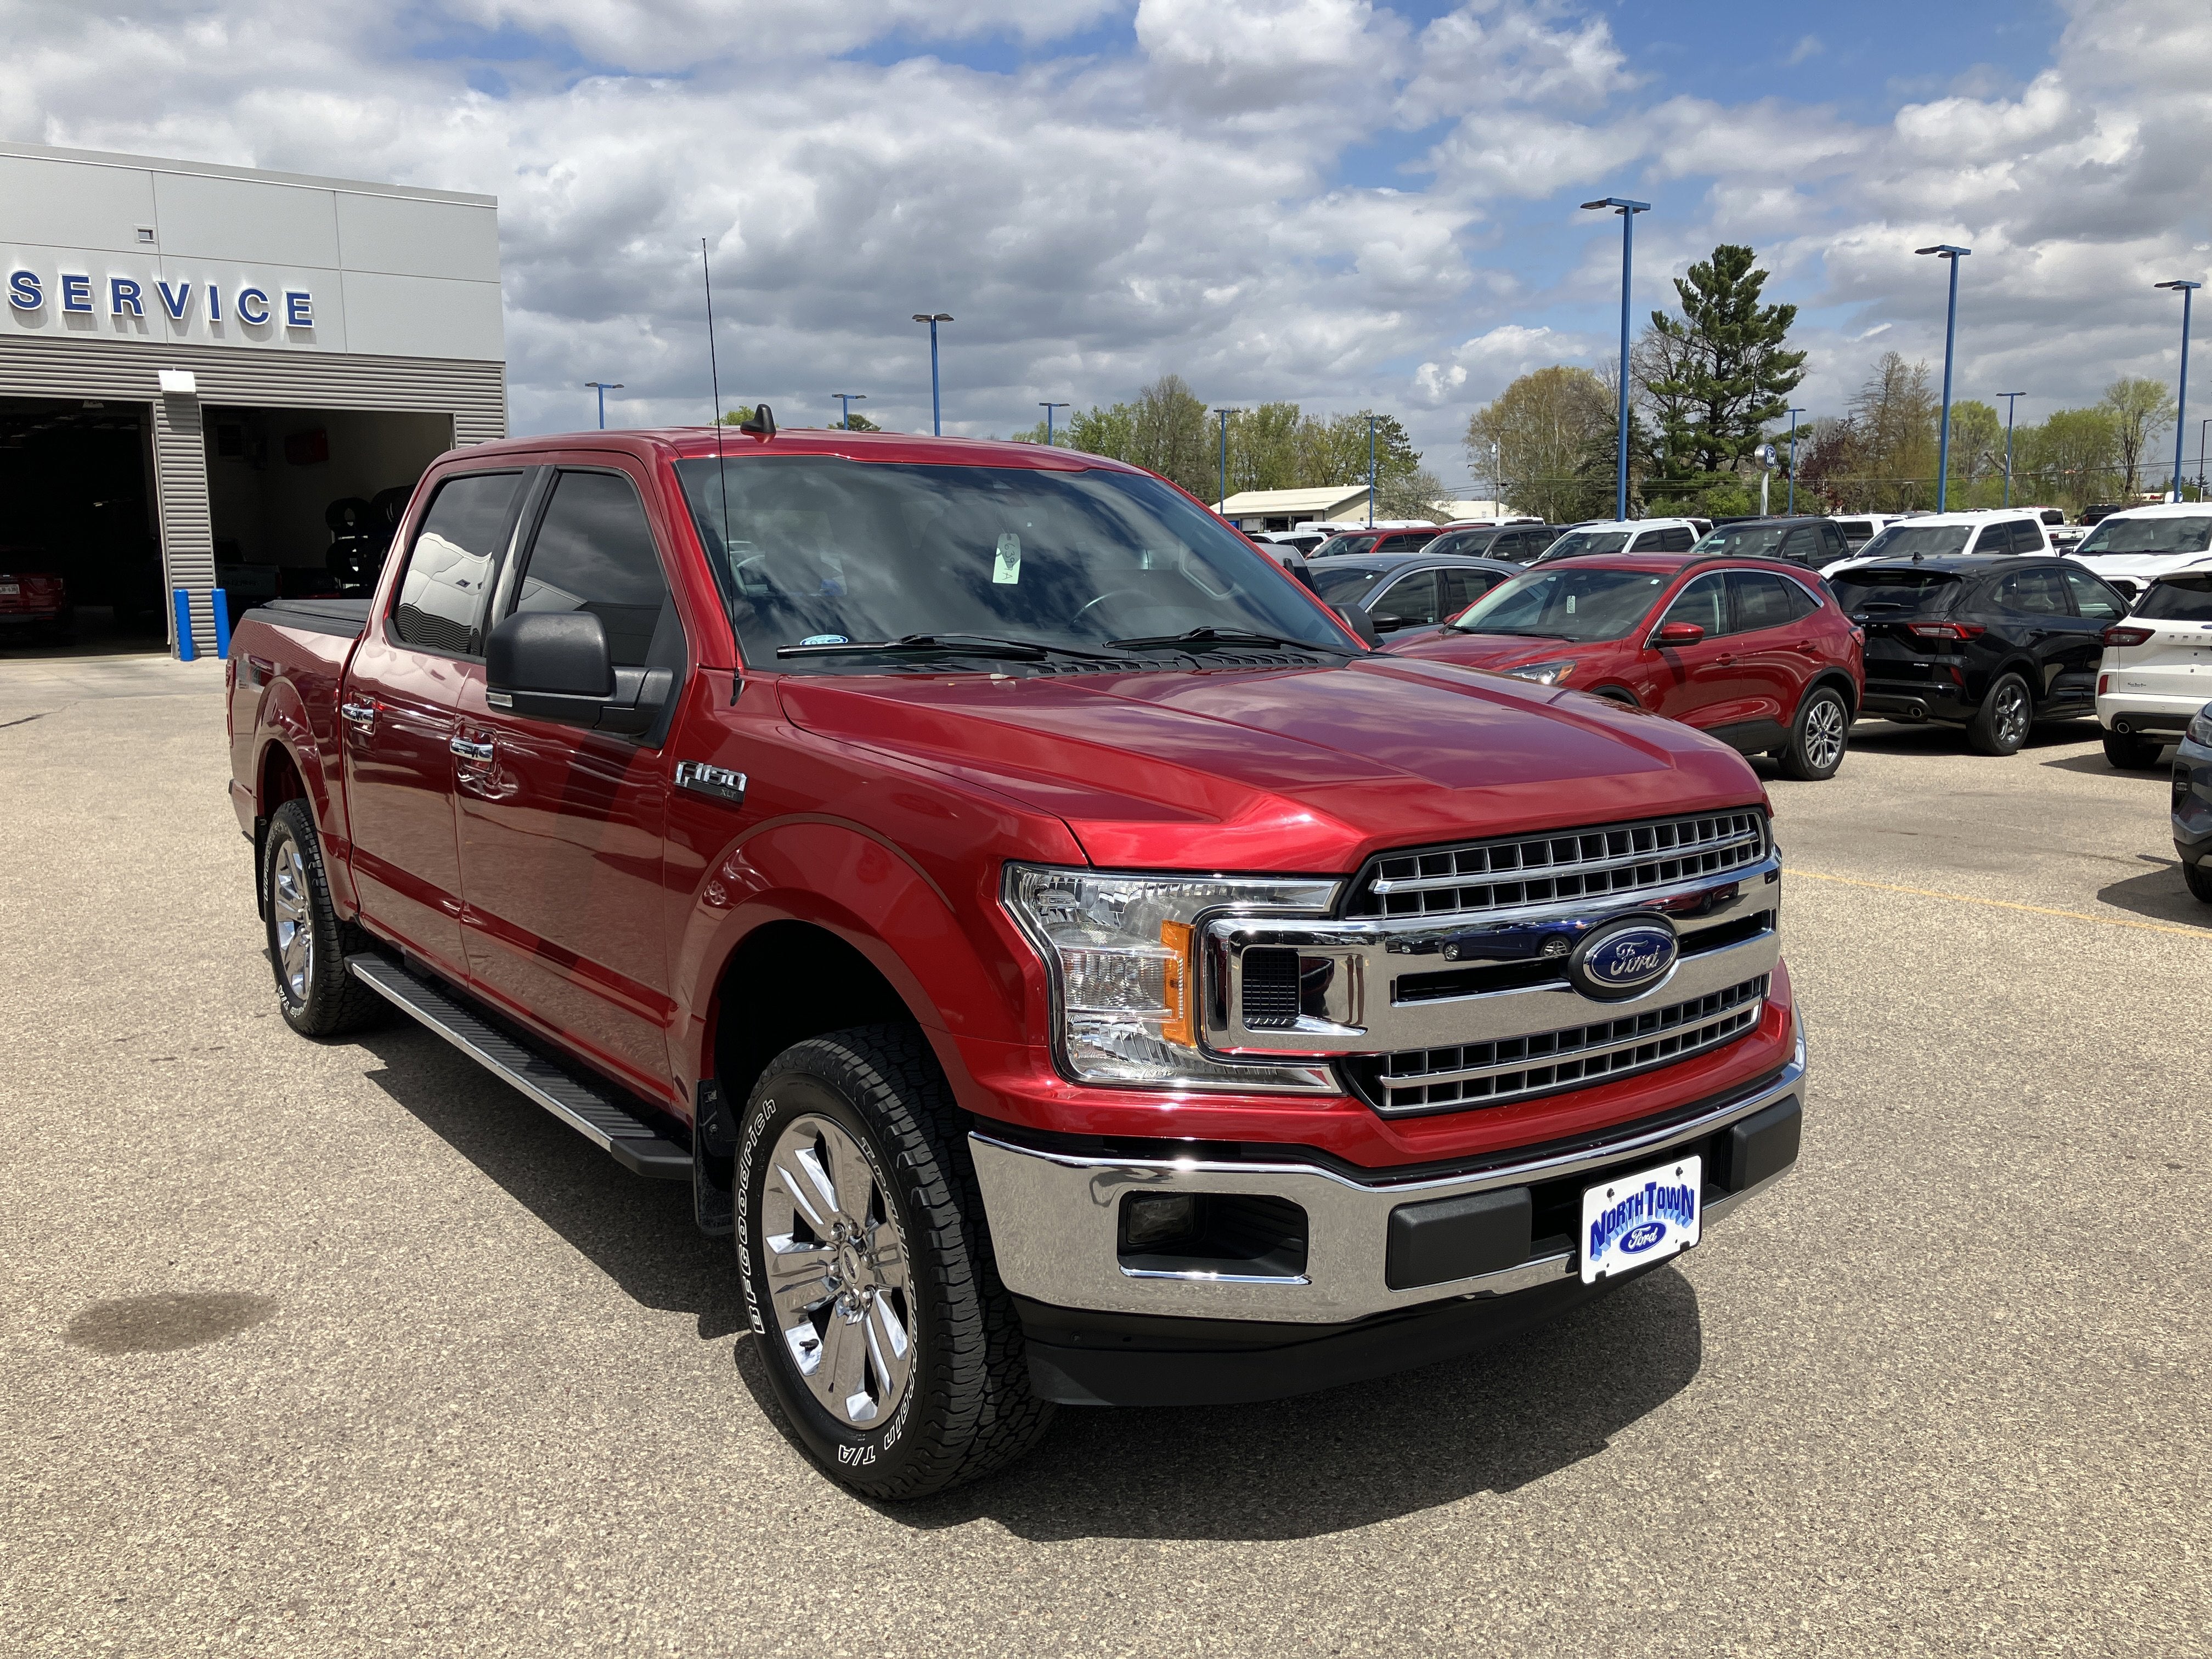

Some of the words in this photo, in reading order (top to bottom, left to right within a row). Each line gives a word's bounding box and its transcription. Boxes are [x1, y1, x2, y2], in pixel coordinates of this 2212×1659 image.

[8, 270, 314, 328] SERVICE
[720, 789, 736, 798] XLT
[1610, 940, 1660, 976] Ford
[738, 1099, 776, 1334] BFGoodrich
[1628, 1226, 1658, 1250] Ford
[838, 1444, 876, 1466] T/A
